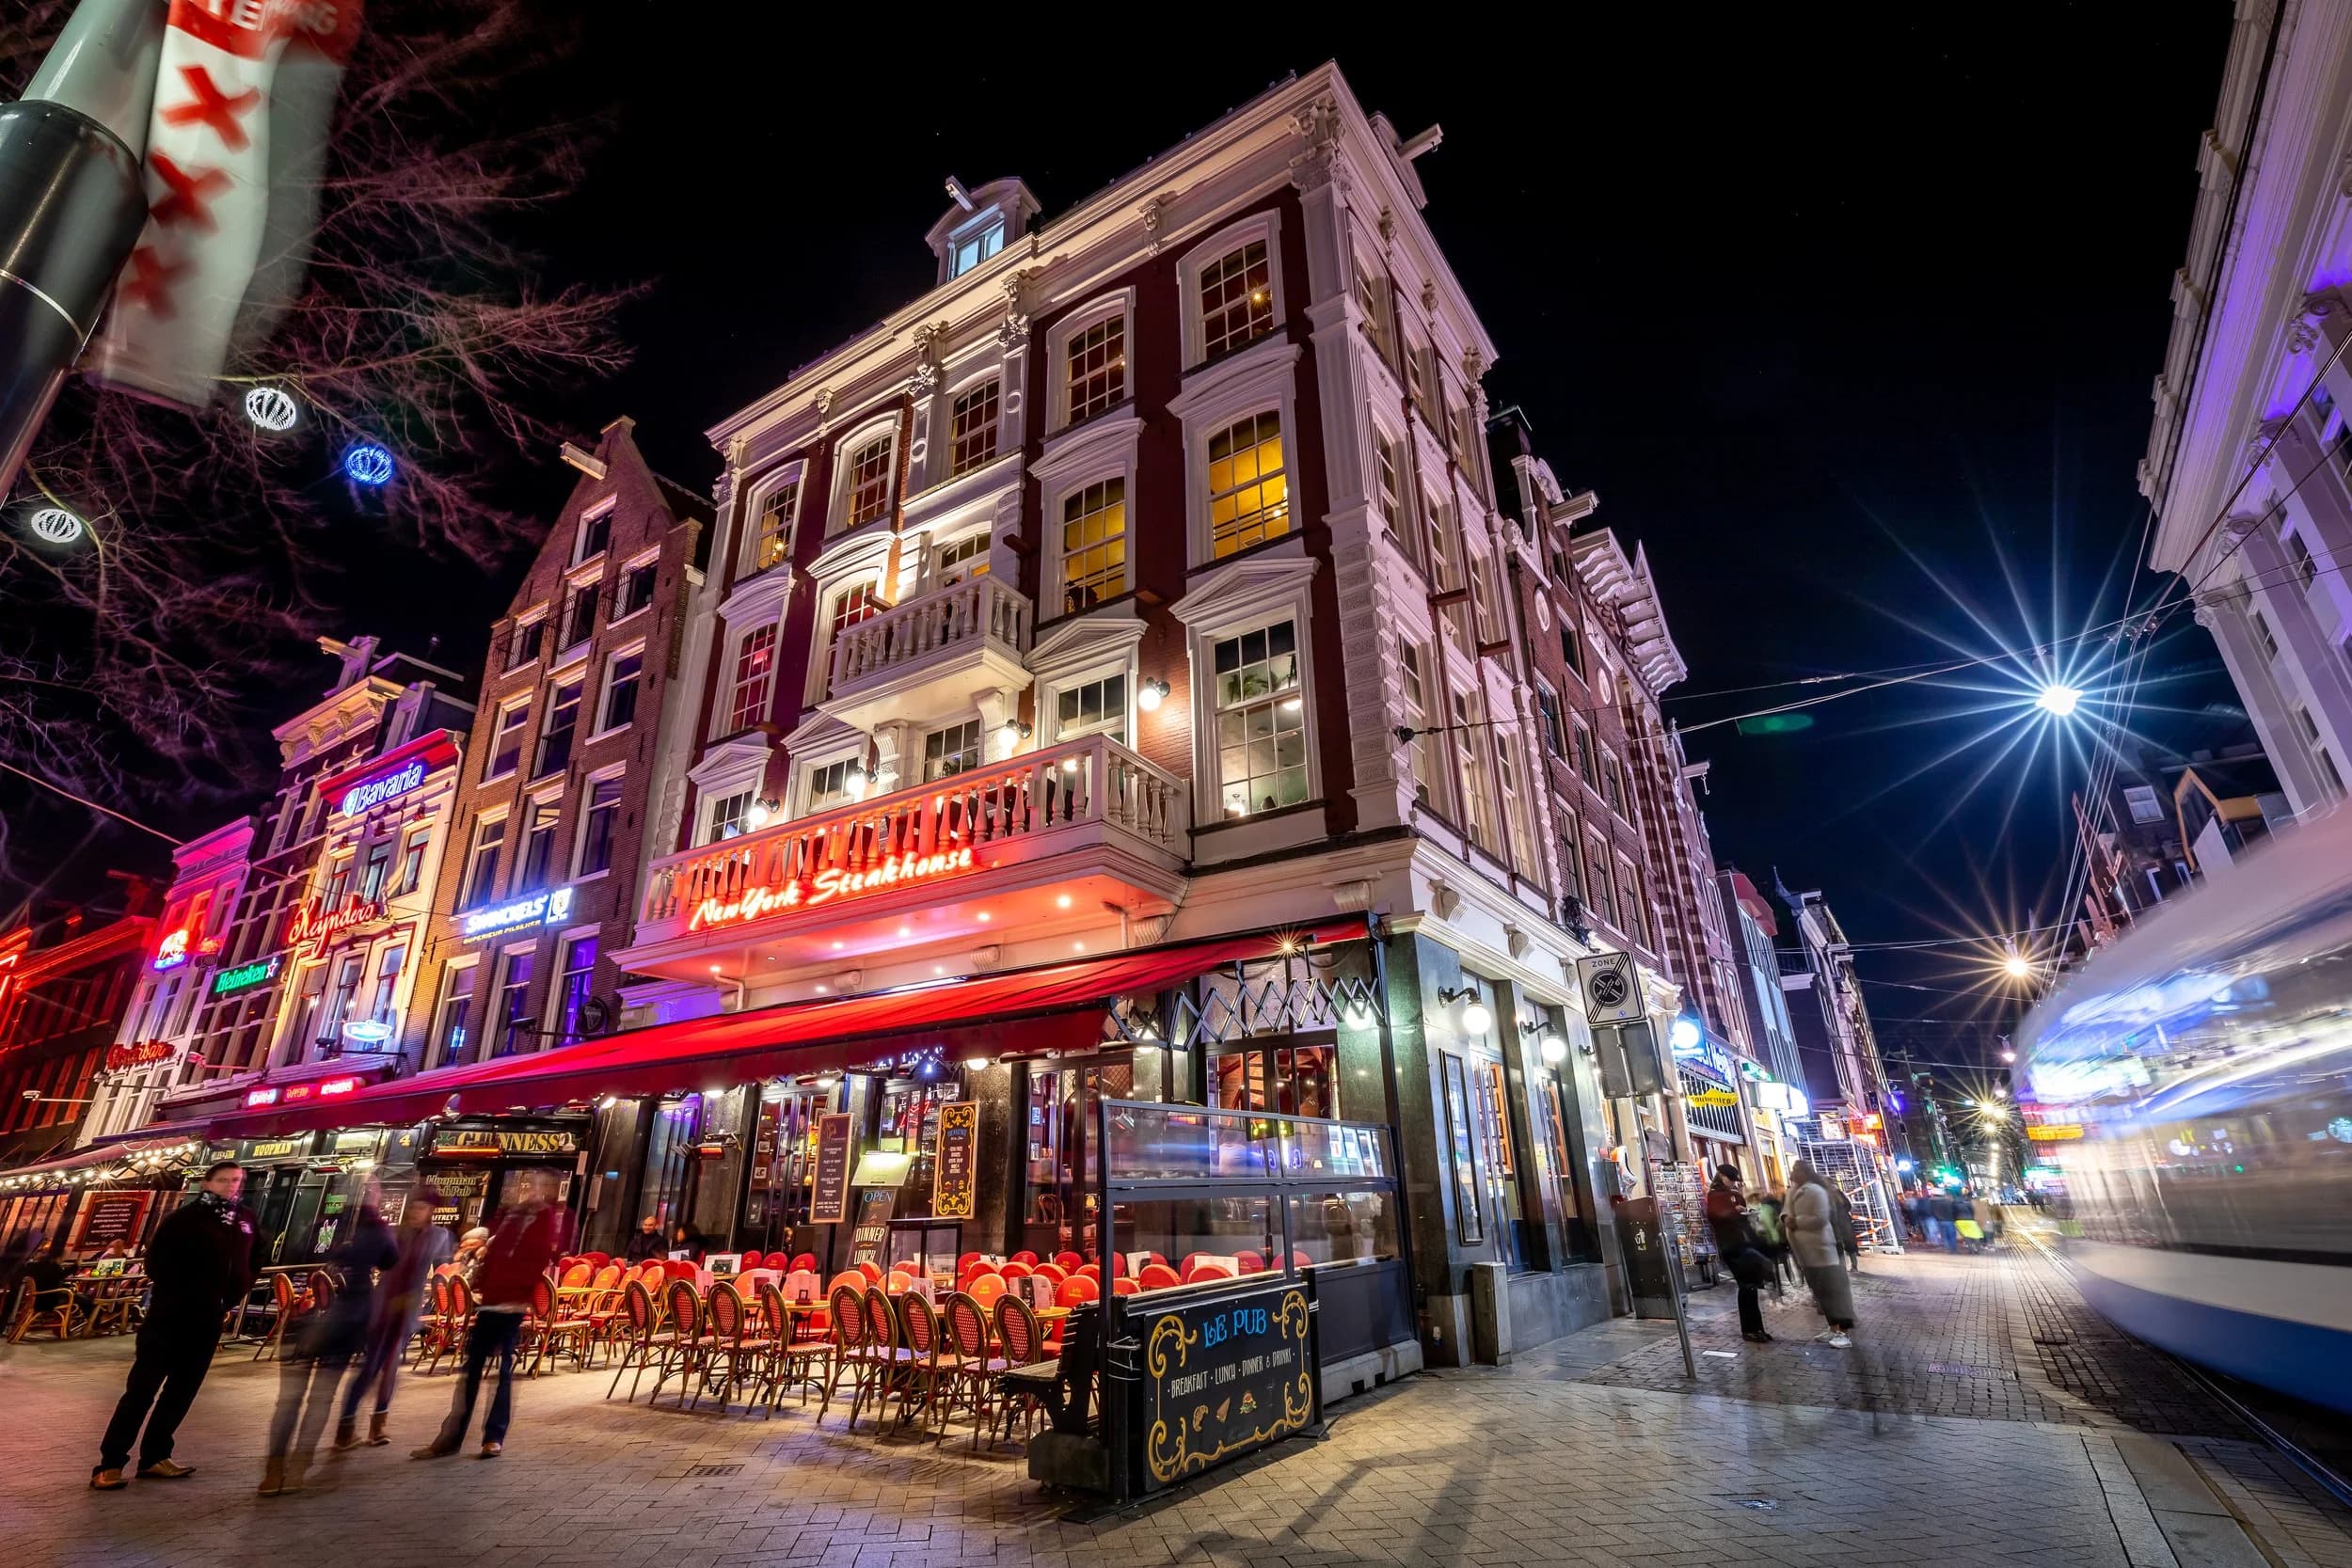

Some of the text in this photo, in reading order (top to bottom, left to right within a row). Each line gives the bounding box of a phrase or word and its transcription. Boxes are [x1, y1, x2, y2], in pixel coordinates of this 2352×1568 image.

[355, 762, 422, 813] Bavaria
[807, 847, 972, 905] Steakhouse
[287, 895, 375, 958] Reynders
[1591, 958, 1615, 968] ZONE
[215, 963, 267, 993] Heineken
[399, 1134, 411, 1148] 4
[252, 1142, 292, 1158] HOOPMAN
[425, 1174, 477, 1187] Hoopman
[865, 1191, 893, 1203] OPEN
[855, 1227, 885, 1243] DINNER
[853, 1249, 877, 1265] LUNCH
[1203, 1308, 1267, 1348] LE PUB
[1171, 1370, 1209, 1399] BREAKFAST
[1215, 1363, 1236, 1385] LUNCH
[1242, 1355, 1264, 1377] DINNER
[1272, 1348, 1292, 1369] DRINKS
